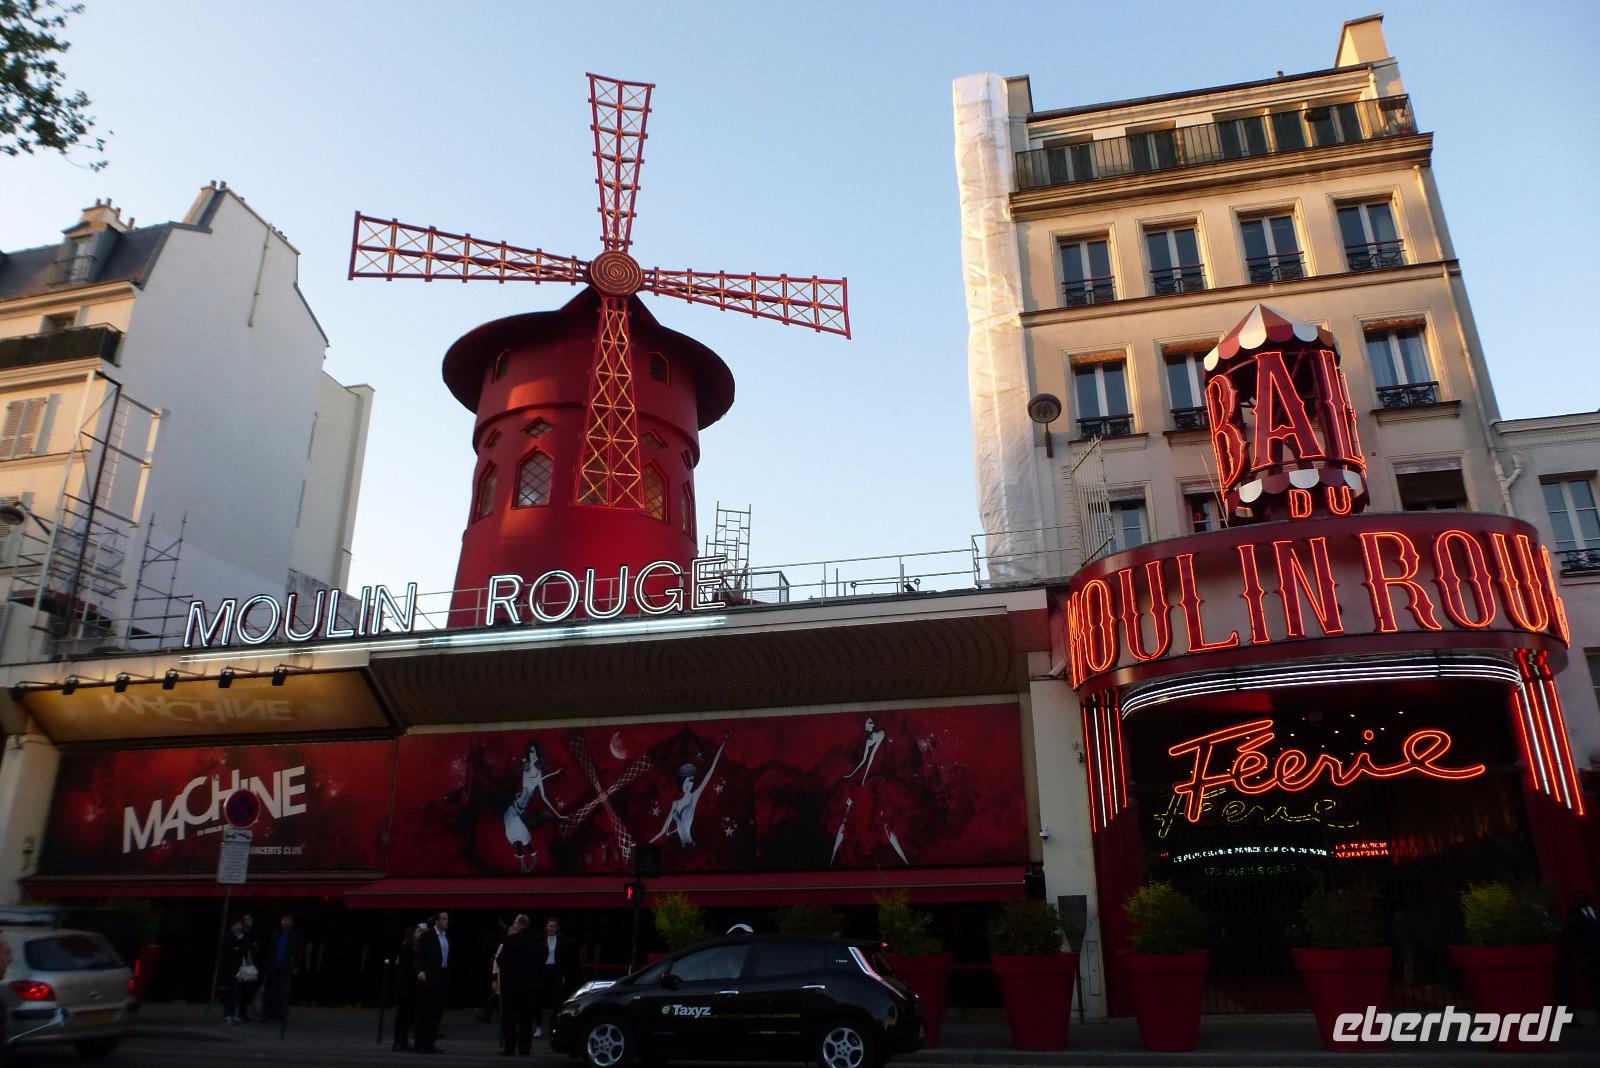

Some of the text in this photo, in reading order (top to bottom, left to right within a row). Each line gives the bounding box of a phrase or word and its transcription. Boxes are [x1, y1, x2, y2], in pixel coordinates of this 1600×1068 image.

[1203, 350, 1369, 502] BAL
[1289, 485, 1352, 518] DU
[183, 555, 727, 649] MOULIN ROUGE
[1067, 528, 1571, 690] MOULIN ROUG
[121, 765, 307, 854] MACHNE
[1168, 718, 1487, 824] Féerie
[248, 846, 302, 855] ONCERTS CLUB
